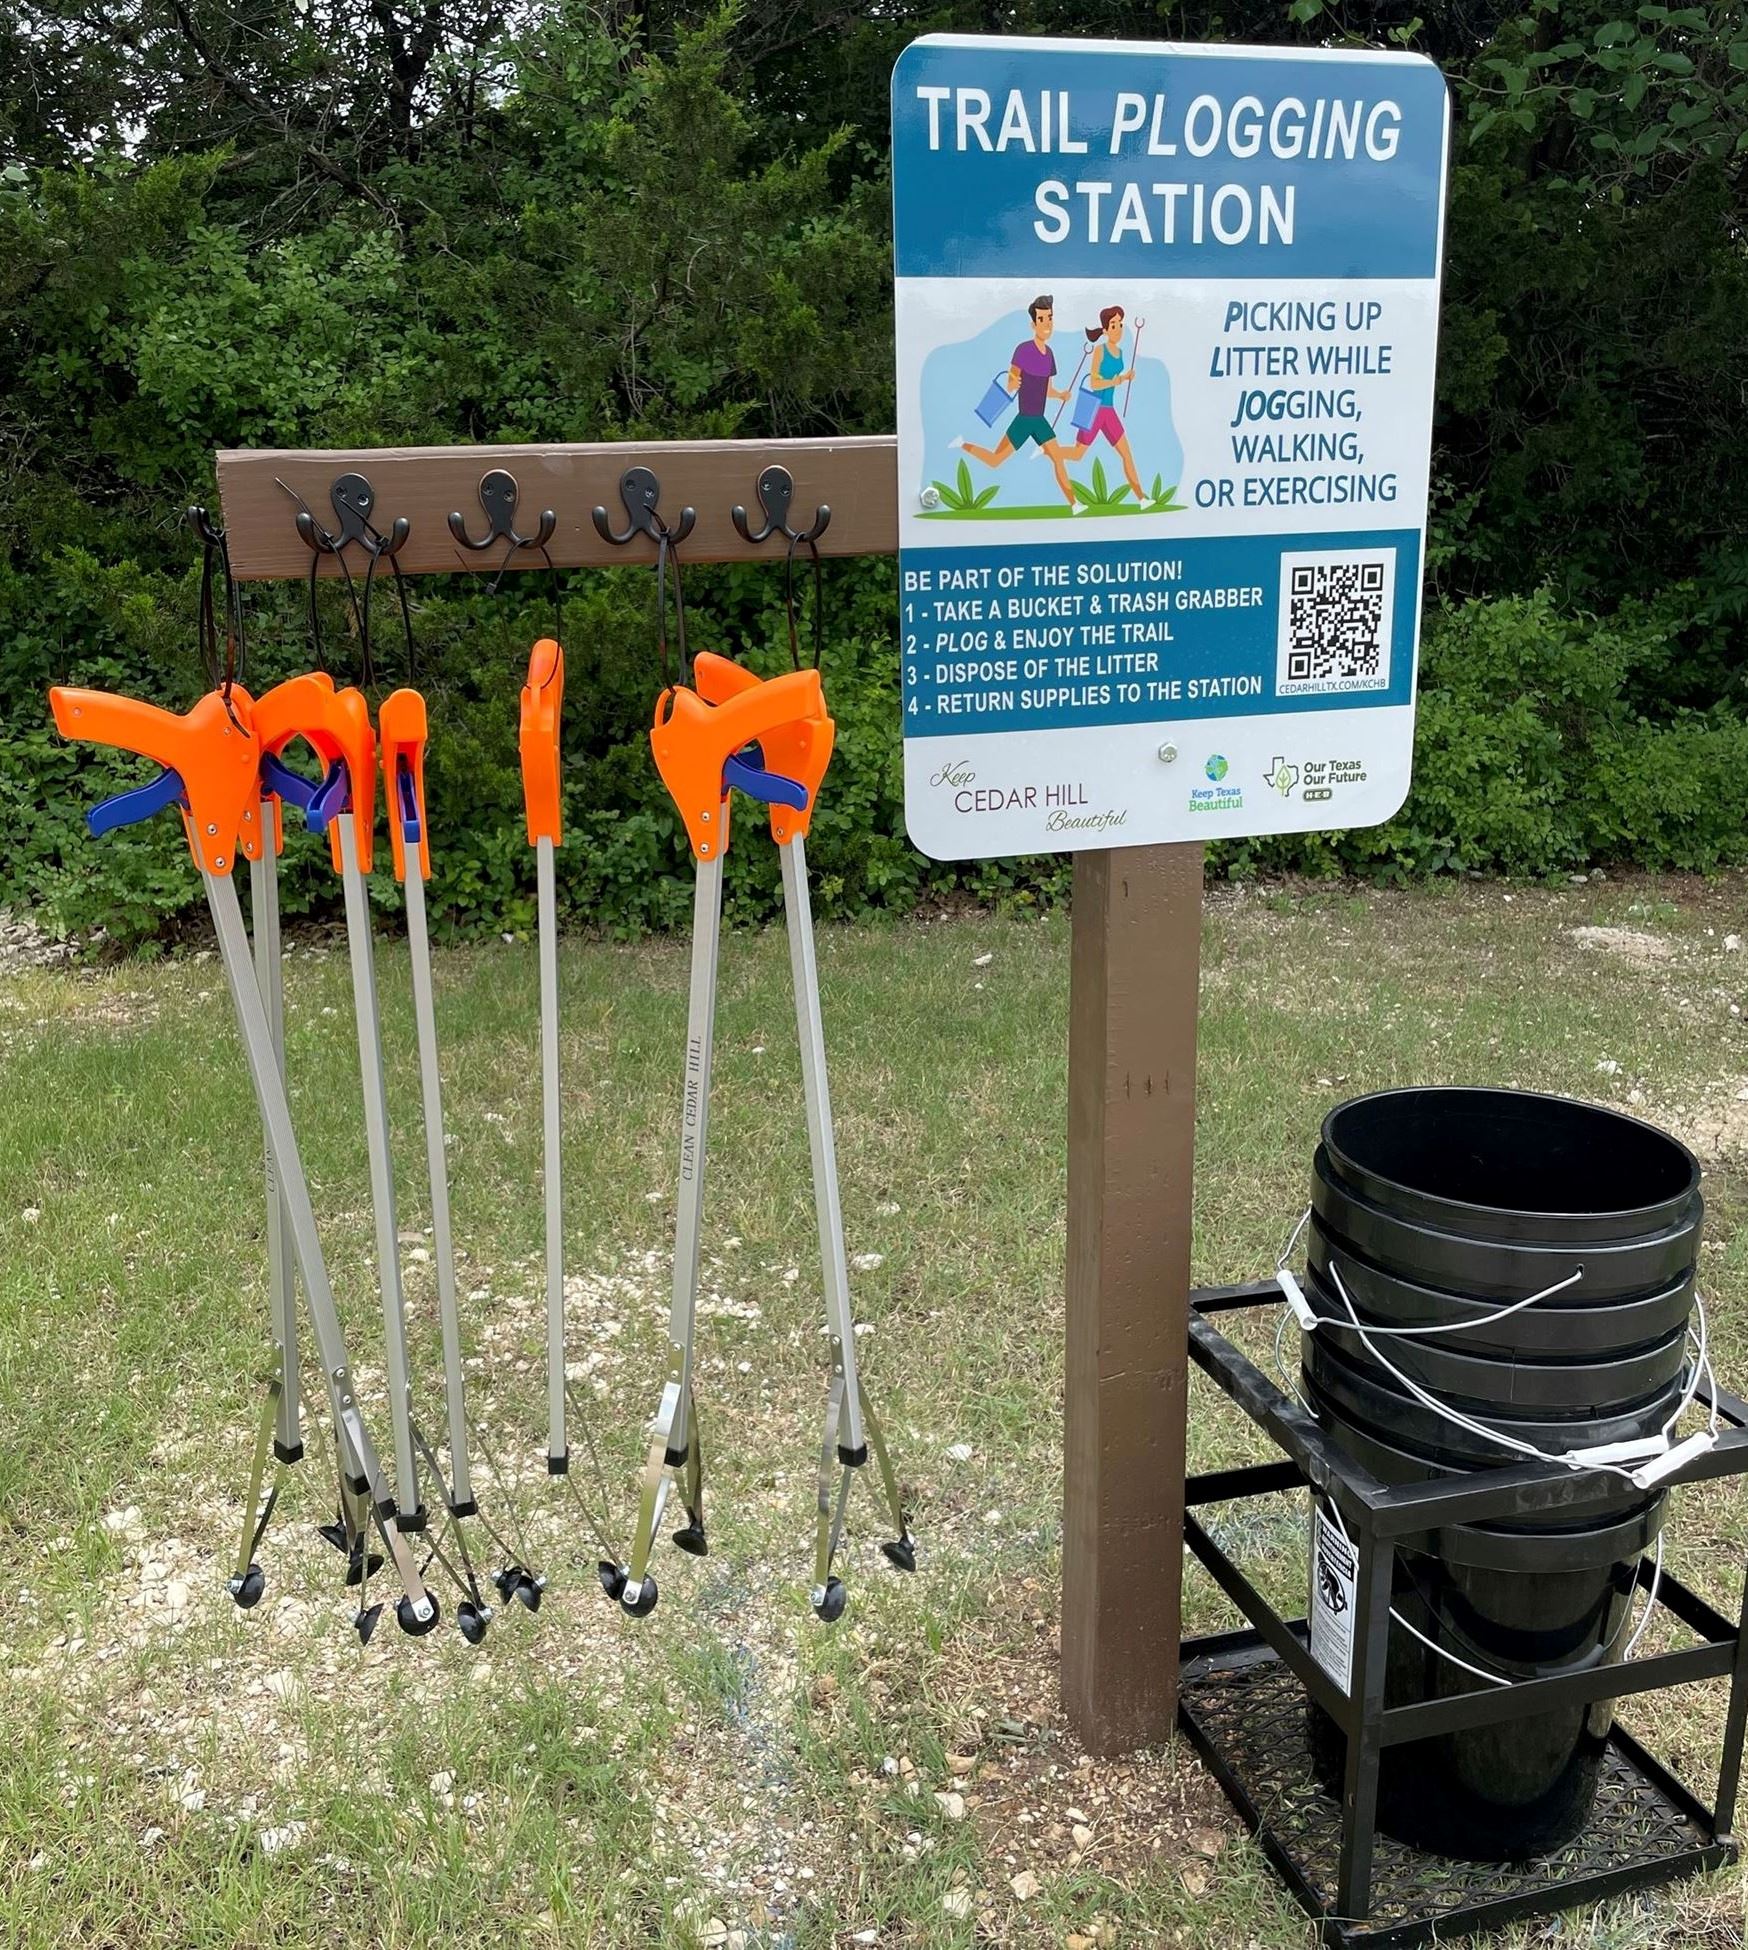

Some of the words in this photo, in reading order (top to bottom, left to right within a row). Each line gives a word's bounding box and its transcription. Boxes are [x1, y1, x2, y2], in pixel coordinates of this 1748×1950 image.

[916, 86, 1088, 155] TRAIL
[1109, 91, 1402, 161] PLOGGING
[1032, 180, 1296, 246] STATION
[1223, 301, 1336, 332] PICKING
[1345, 301, 1382, 331] UP
[1209, 346, 1299, 377] LITTER
[1306, 345, 1392, 375] WHILE
[1230, 389, 1362, 428] JOGGING,
[1231, 432, 1364, 465] WALKING,
[1195, 479, 1235, 508] OR
[1243, 473, 1397, 506] EXERCISING
[904, 570, 932, 592] BE
[939, 568, 992, 590] PART
[998, 567, 1025, 588] OF
[1031, 565, 1070, 586] THE
[1076, 560, 1183, 585] SOLUTION!
[905, 603, 914, 623] 1
[933, 600, 983, 622] TAKE
[988, 599, 1002, 620] A
[1007, 595, 1085, 619] BUCKET
[1089, 594, 1102, 615] &
[1108, 591, 1169, 614] TRASH
[1175, 586, 1263, 610] GRABBER
[906, 634, 917, 655] 2
[935, 630, 989, 653] PLOG
[994, 630, 1007, 650] &
[1013, 626, 1075, 649] ENJOY
[1080, 624, 1115, 646] THE
[1121, 621, 1174, 643] TRAIL
[907, 665, 917, 686] 3
[935, 660, 1018, 684] DISPOSE
[1023, 658, 1049, 679] OF
[1054, 656, 1090, 677] THE
[1096, 652, 1159, 675] LITTER
[907, 695, 919, 716] 4
[937, 691, 1014, 714] RETURN
[1020, 684, 1111, 709] SUPPLIES
[1116, 683, 1141, 703] TO
[1146, 680, 1182, 701] THE
[1187, 675, 1262, 699] STATION
[1278, 678, 1386, 694] CEDARHILLTX.COM/KCHB
[929, 760, 976, 788] Keep
[1303, 774, 1326, 785] Our
[1328, 772, 1367, 784] Future
[1304, 762, 1326, 773] Our
[1329, 760, 1361, 771] Texas
[954, 787, 1037, 813] CEDAR
[1046, 783, 1088, 807] HILL
[1188, 796, 1243, 812] Beautiful
[1191, 788, 1214, 800] Keep
[1216, 787, 1241, 797] Texas
[1046, 809, 1127, 832] Beautiful
[688, 1036, 702, 1072] HILL
[685, 1079, 699, 1127] CEDAR
[682, 1134, 696, 1181] CLEAN
